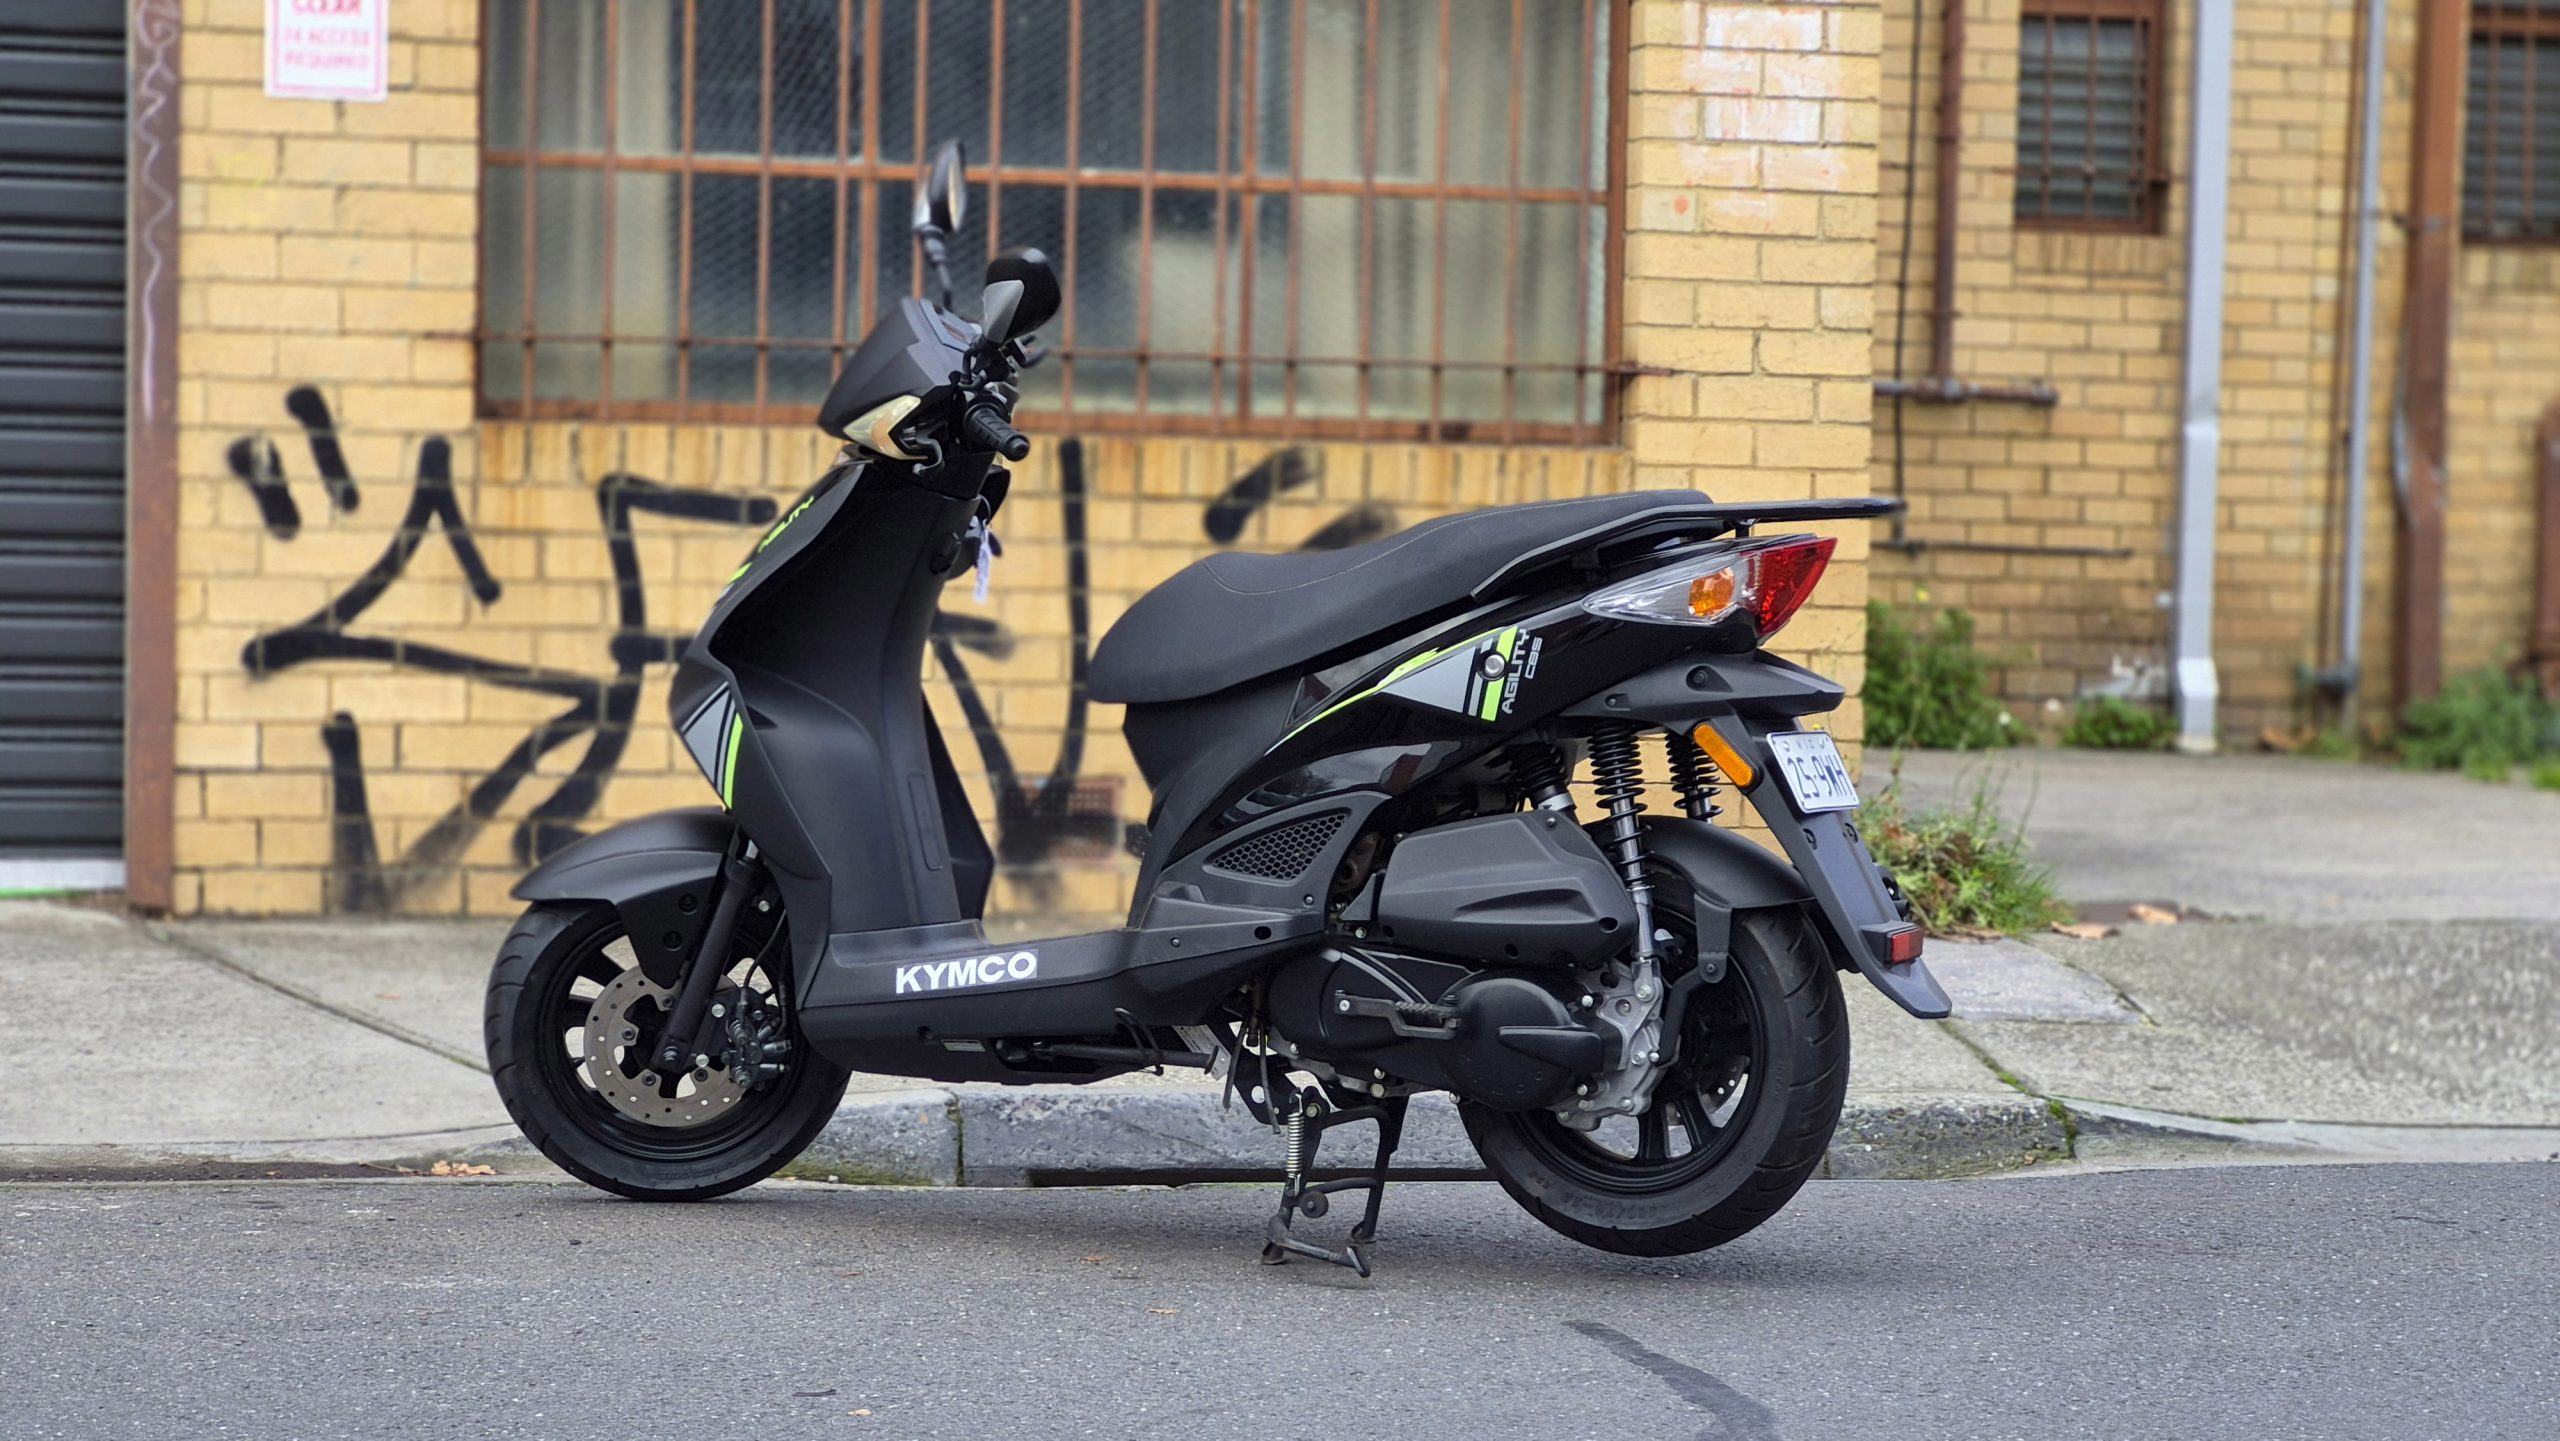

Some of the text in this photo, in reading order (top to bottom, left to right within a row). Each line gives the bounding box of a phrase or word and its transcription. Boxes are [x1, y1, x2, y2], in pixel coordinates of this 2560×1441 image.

[1501, 628, 1530, 715] AGILITY
[1524, 636, 1543, 680] CBS
[895, 951, 1038, 994] KYMCO
